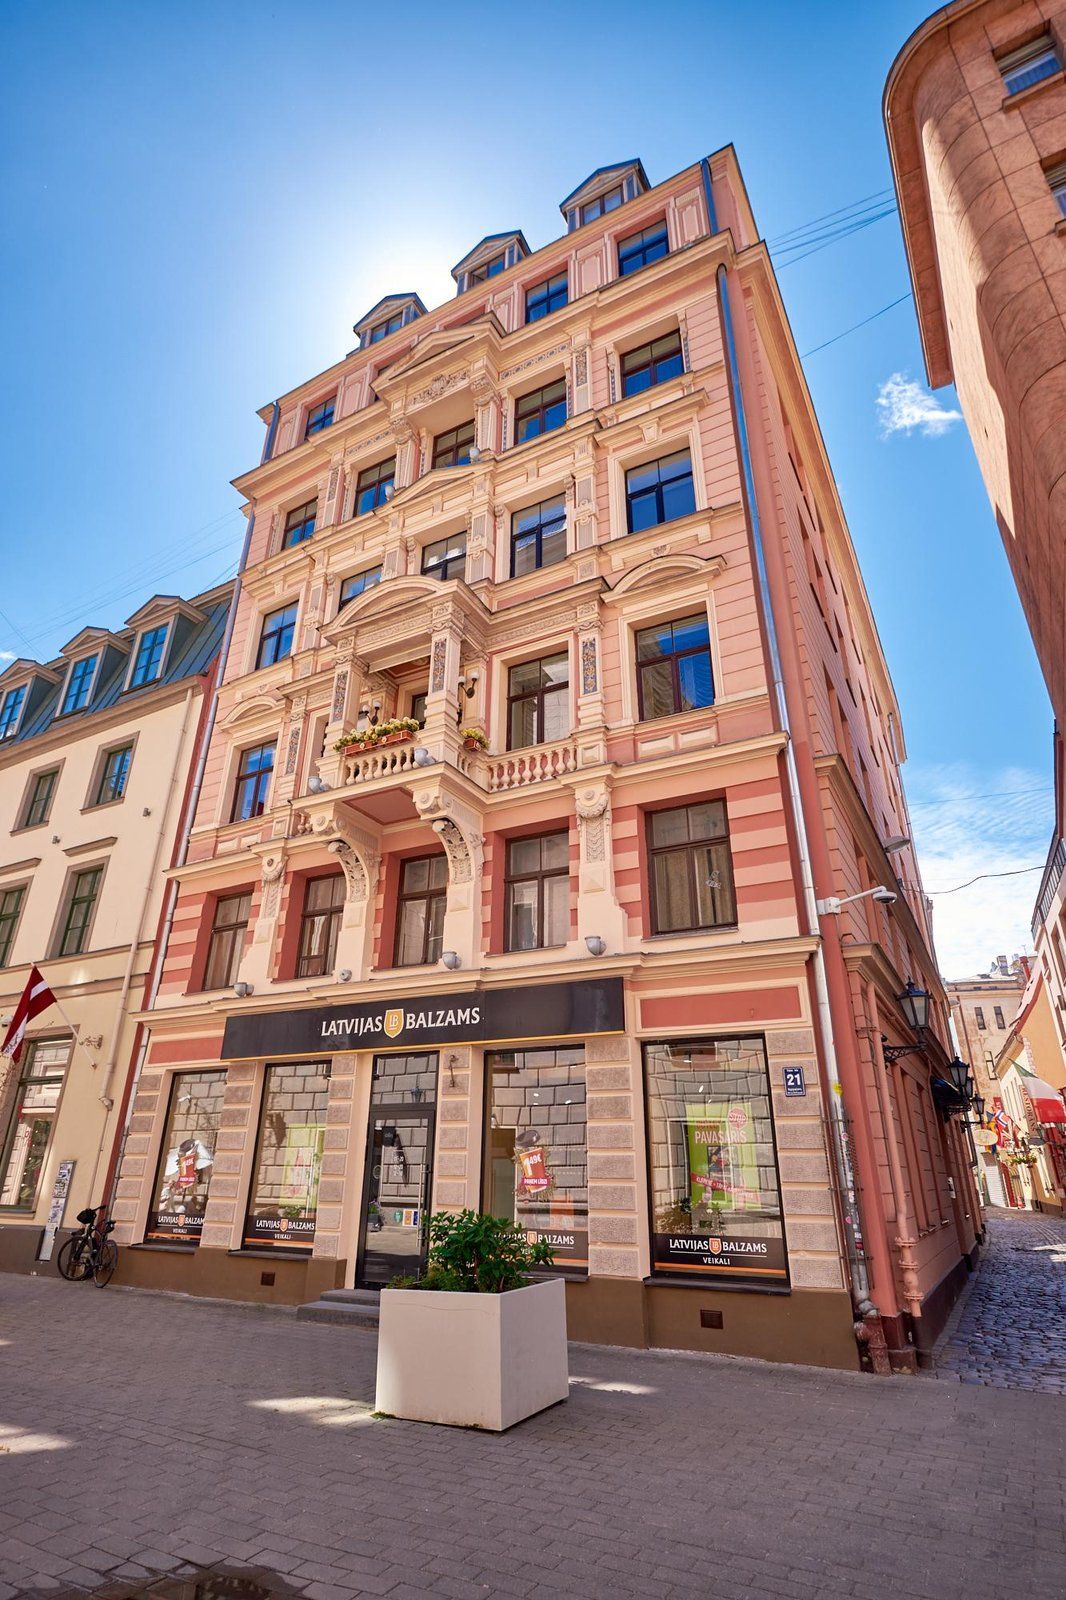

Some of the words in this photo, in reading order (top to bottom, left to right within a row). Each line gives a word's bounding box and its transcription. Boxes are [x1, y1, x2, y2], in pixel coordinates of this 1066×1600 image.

[320, 1016, 383, 1037] LATVIJAS
[405, 1007, 481, 1030] BALZAMS
[786, 1073, 801, 1086] 21
[694, 1130, 748, 1144] PAVASARIS
[157, 1215, 179, 1226] LATVIJAS
[184, 1216, 205, 1225] BALZAM
[255, 1219, 281, 1230] LATVIJAS
[288, 1220, 315, 1231] BALZAMS
[669, 1238, 709, 1251] LATVIJAS
[722, 1241, 768, 1253] BALZAMS
[702, 1256, 731, 1266] VEIKALI
